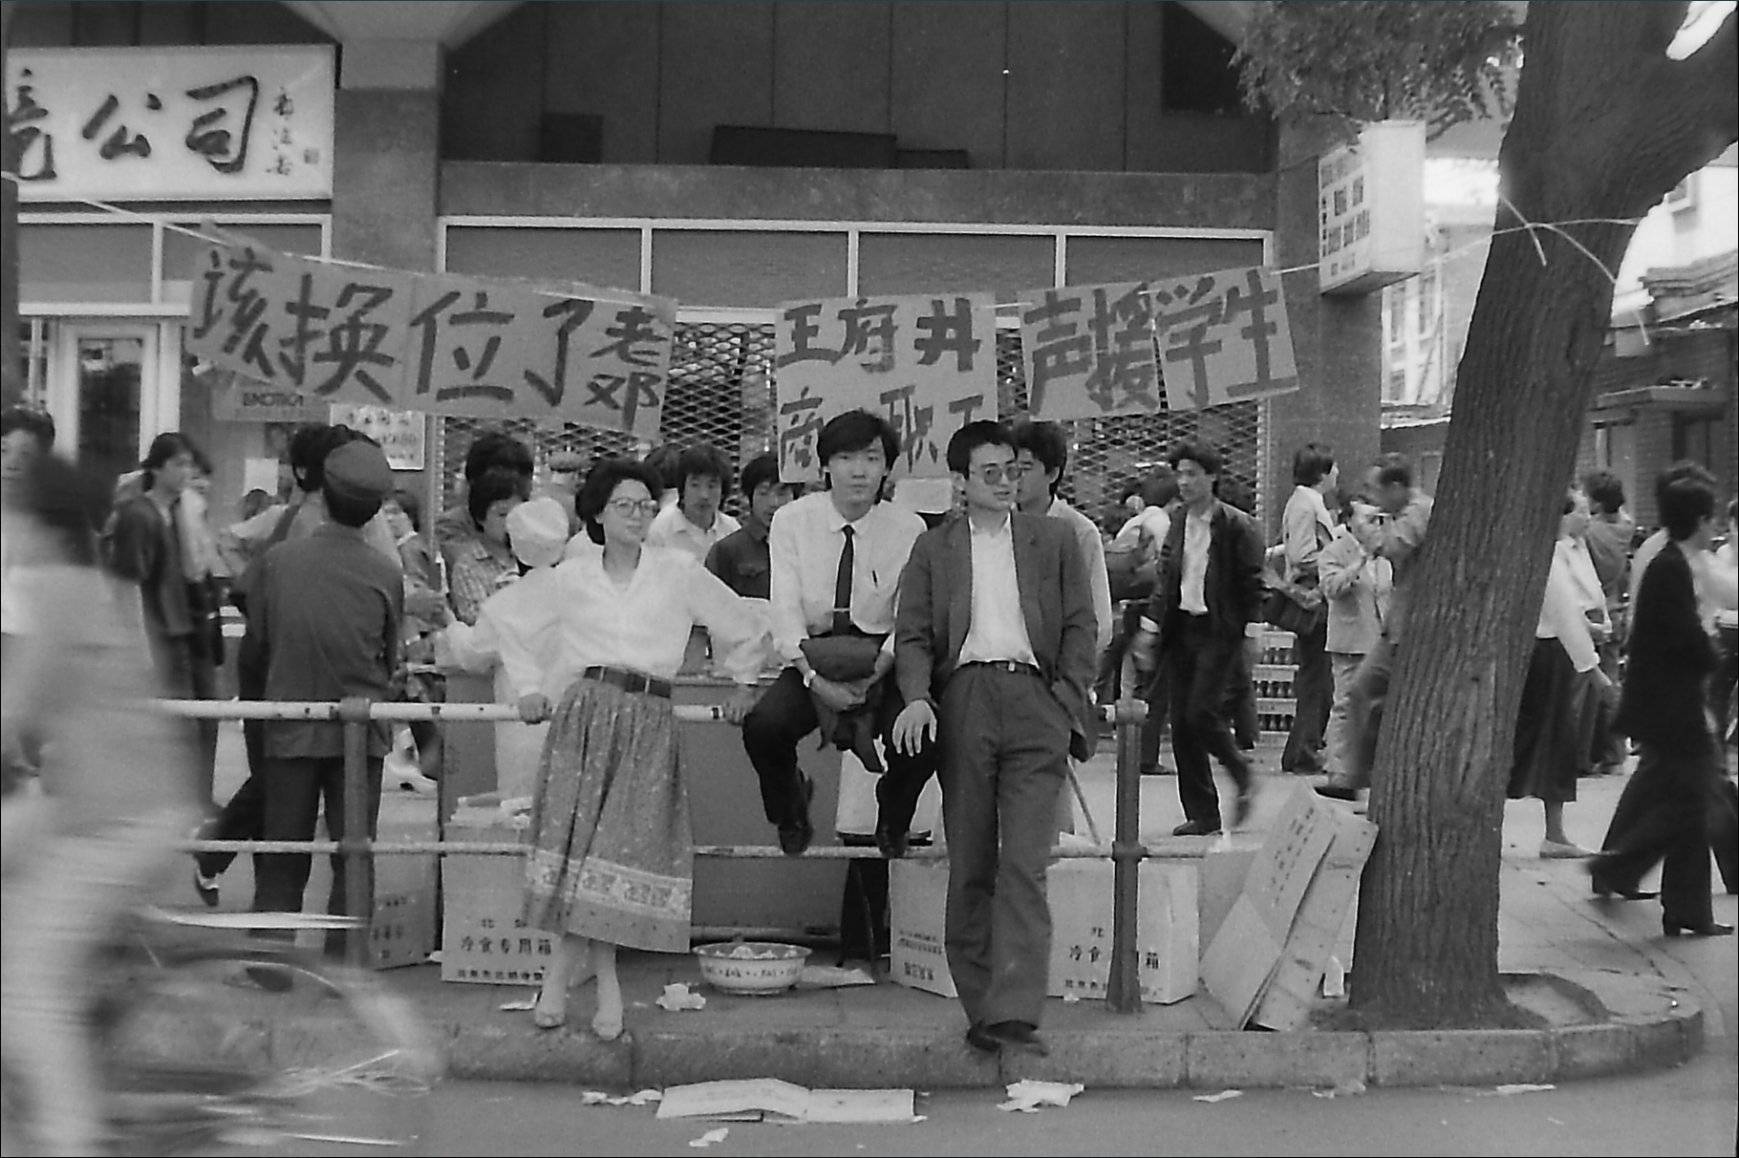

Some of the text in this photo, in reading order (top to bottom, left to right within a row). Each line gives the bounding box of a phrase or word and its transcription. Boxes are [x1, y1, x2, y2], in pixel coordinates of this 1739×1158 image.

[776, 297, 982, 373] 王府井
[1022, 266, 1298, 416] 声援学生
[780, 384, 984, 476] 商职
[1069, 945, 1159, 970] 冷食箱
